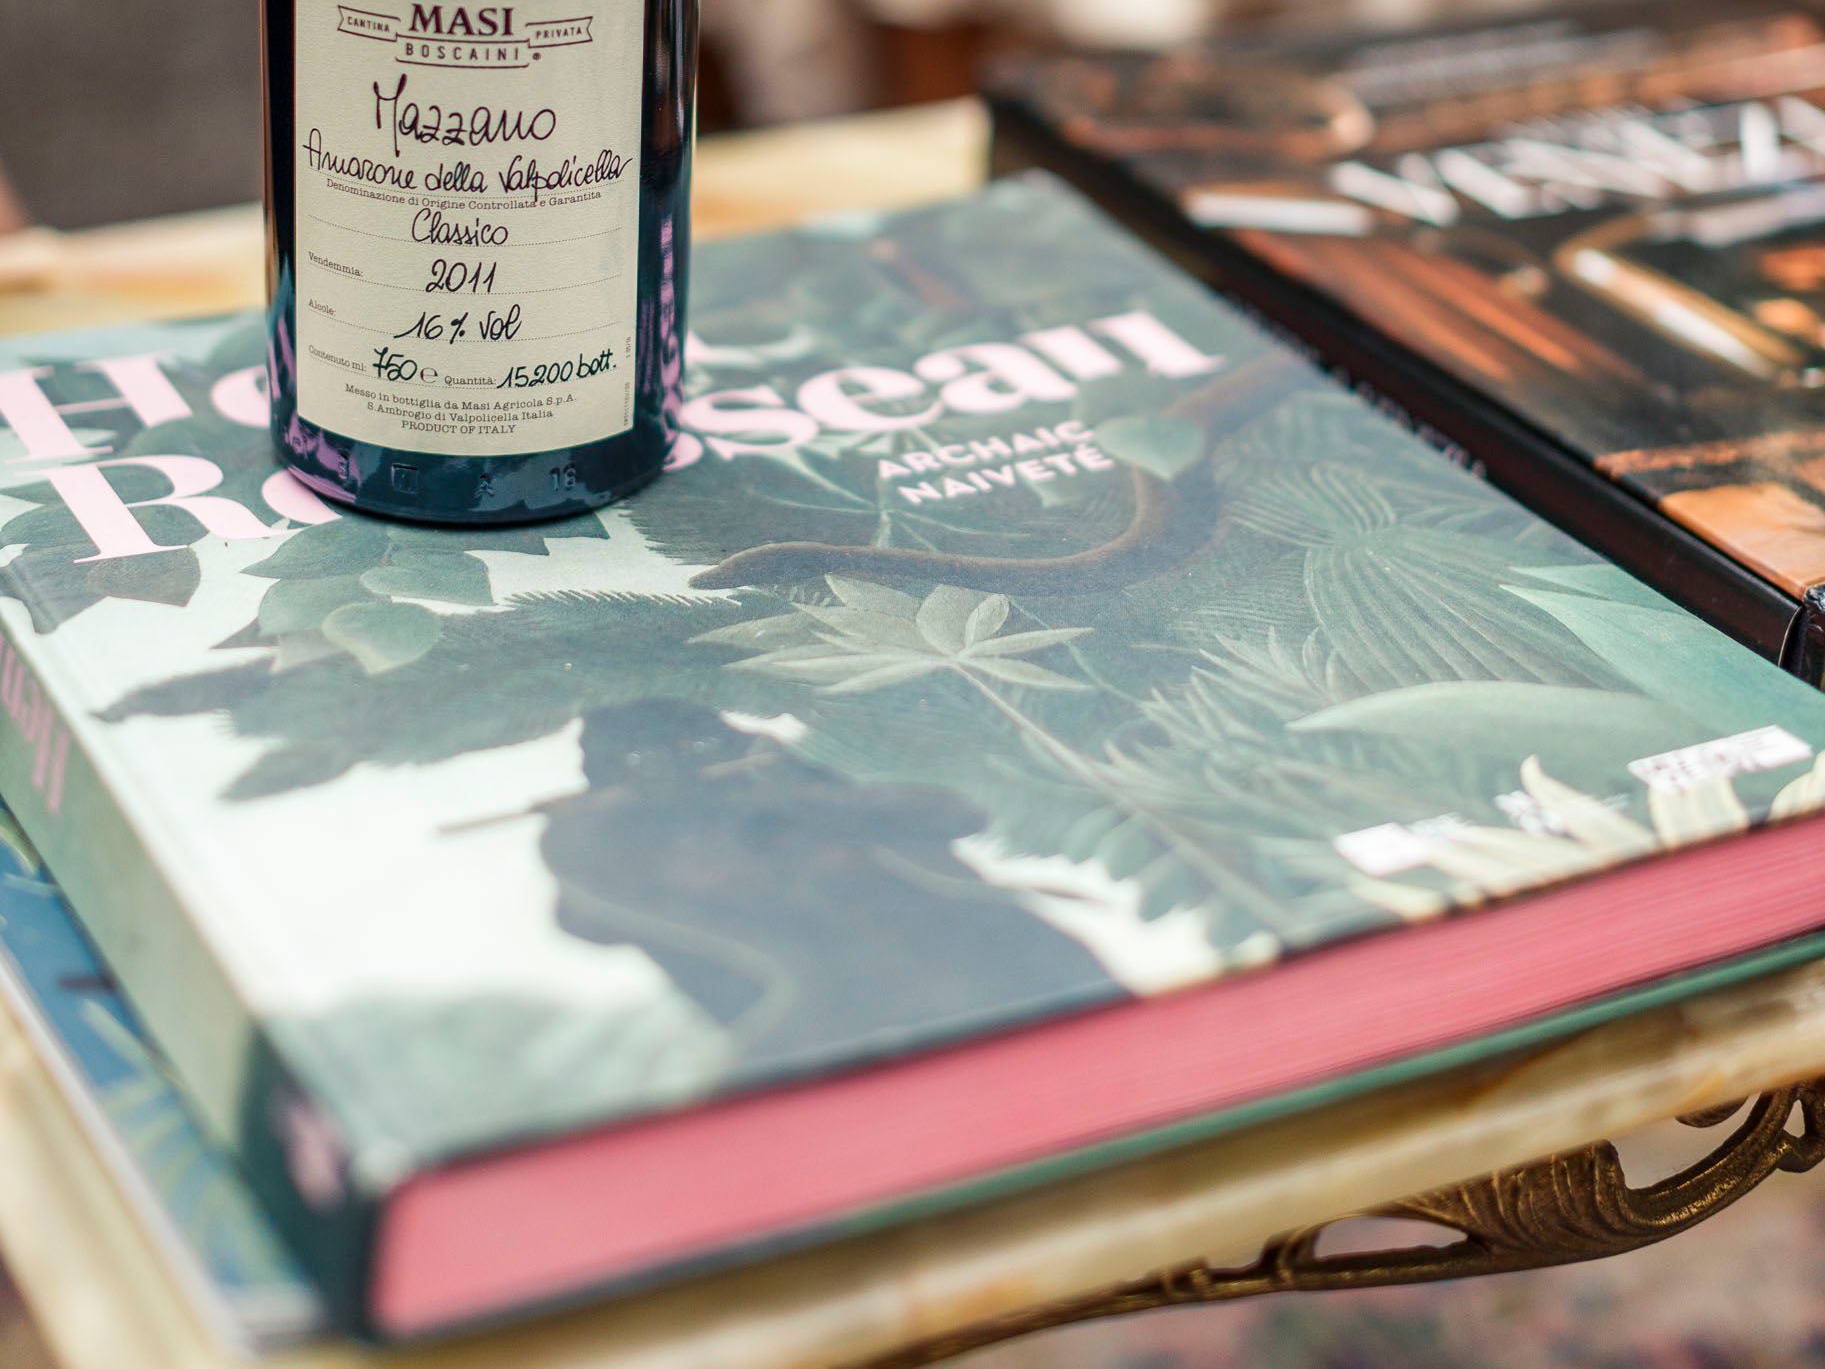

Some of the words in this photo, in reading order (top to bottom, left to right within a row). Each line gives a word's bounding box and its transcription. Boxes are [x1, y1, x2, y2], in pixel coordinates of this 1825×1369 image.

[347, 15, 391, 34] CANTINA
[409, 3, 515, 36] MASI
[535, 27, 583, 40] PRIVATA
[406, 43, 519, 61] BOSCAINI
[373, 73, 556, 158] Mazzano
[303, 128, 417, 189] Amarone
[425, 162, 487, 192] della
[499, 149, 633, 202] Valpolicella
[326, 178, 406, 205] Denominazione
[408, 195, 419, 206] di
[422, 197, 466, 210] Origine
[468, 199, 537, 210] Controllata
[540, 199, 547, 207] e
[549, 190, 602, 207] Garantita
[412, 208, 508, 247] Classico
[308, 251, 363, 277] Vendemmia:
[425, 259, 497, 293] 2011
[308, 298, 336, 316] Alcole:
[308, 344, 351, 368] Contenuto
[353, 361, 366, 372] ml:
[372, 347, 418, 381] 750
[444, 374, 496, 387] Quantità:
[577, 348, 617, 379] bott.
[345, 383, 376, 400] Messo
[378, 392, 390, 402] in
[392, 394, 442, 410] bottiglia
[444, 400, 459, 410] da
[461, 400, 491, 410] Masi
[493, 398, 544, 411] Agricola
[546, 393, 577, 408] S.p.A.
[401, 420, 458, 434] PRODUCT
[460, 425, 475, 434] OF
[477, 424, 517, 434] ITALY
[434, 412, 446, 421] di
[449, 412, 519, 423] Valpolicella
[522, 409, 553, 420] Italia
[878, 420, 1096, 480] ARCHAIC
